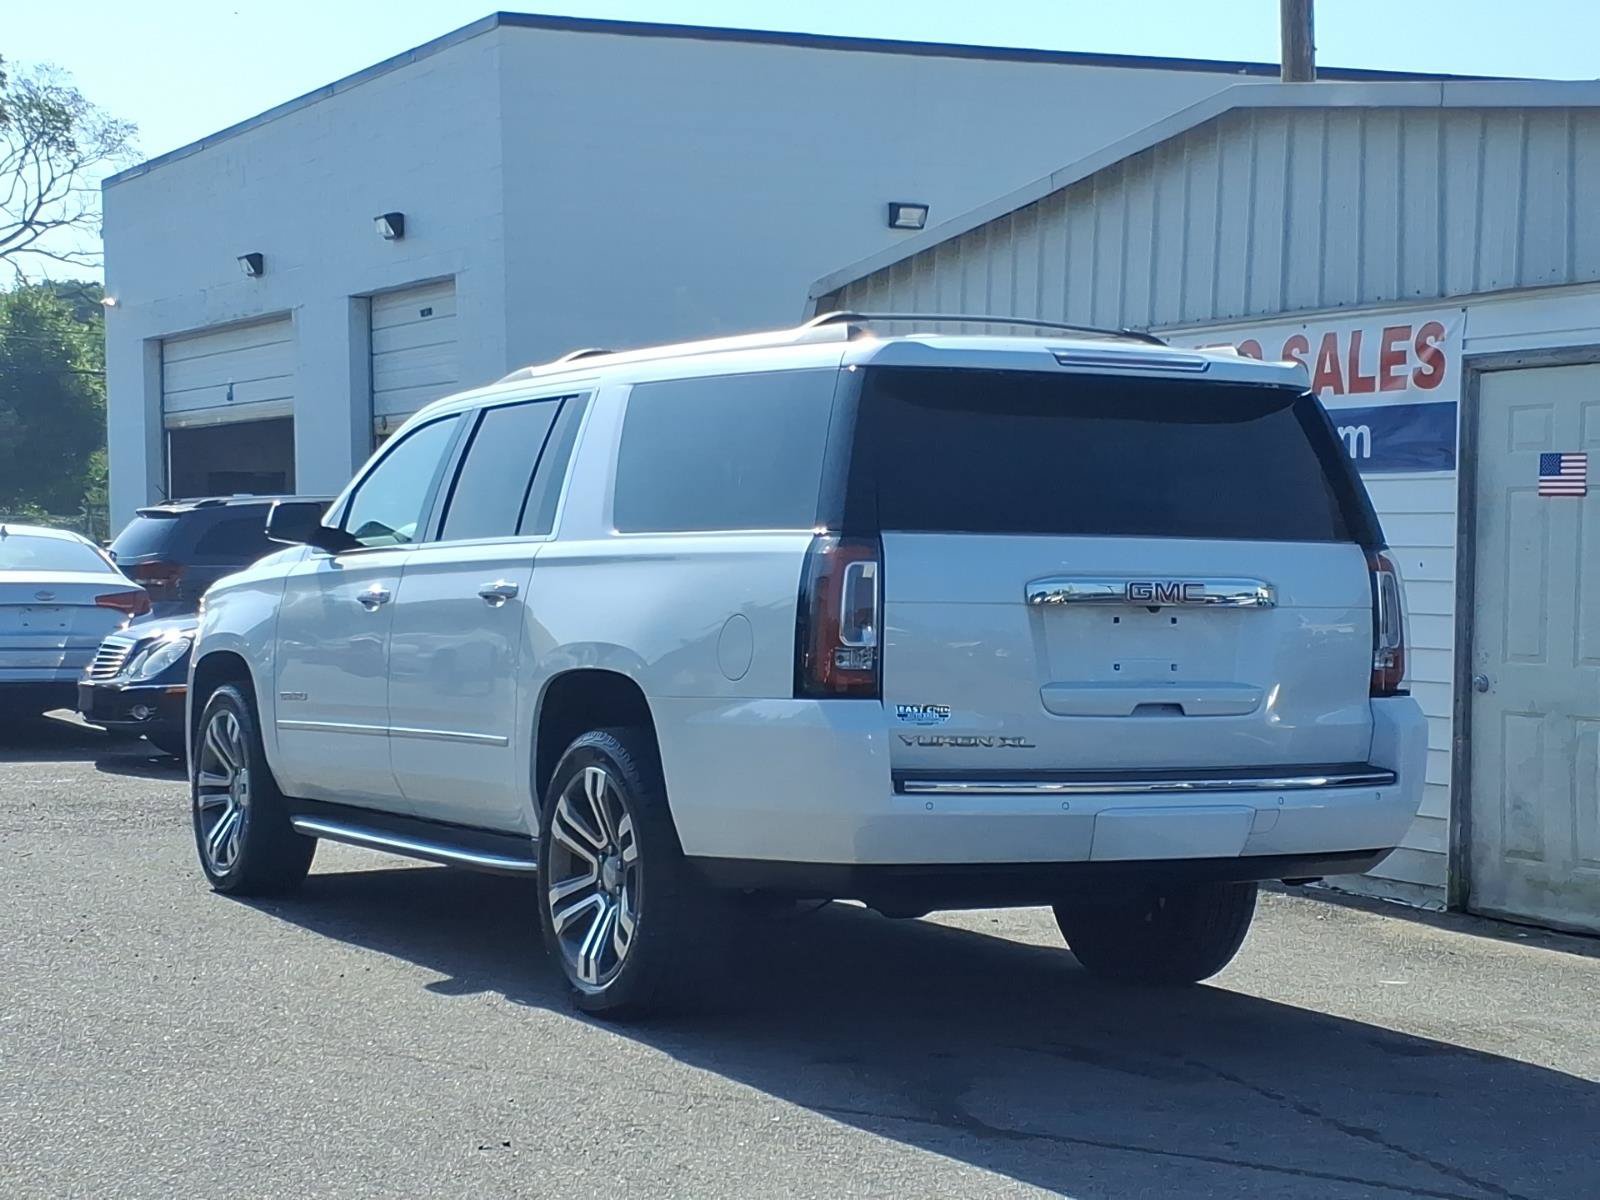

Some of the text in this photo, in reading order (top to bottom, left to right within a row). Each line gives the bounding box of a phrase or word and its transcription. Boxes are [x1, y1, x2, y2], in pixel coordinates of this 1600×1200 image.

[1127, 581, 1206, 603] GMC
[898, 734, 1036, 748] YUKON XL
